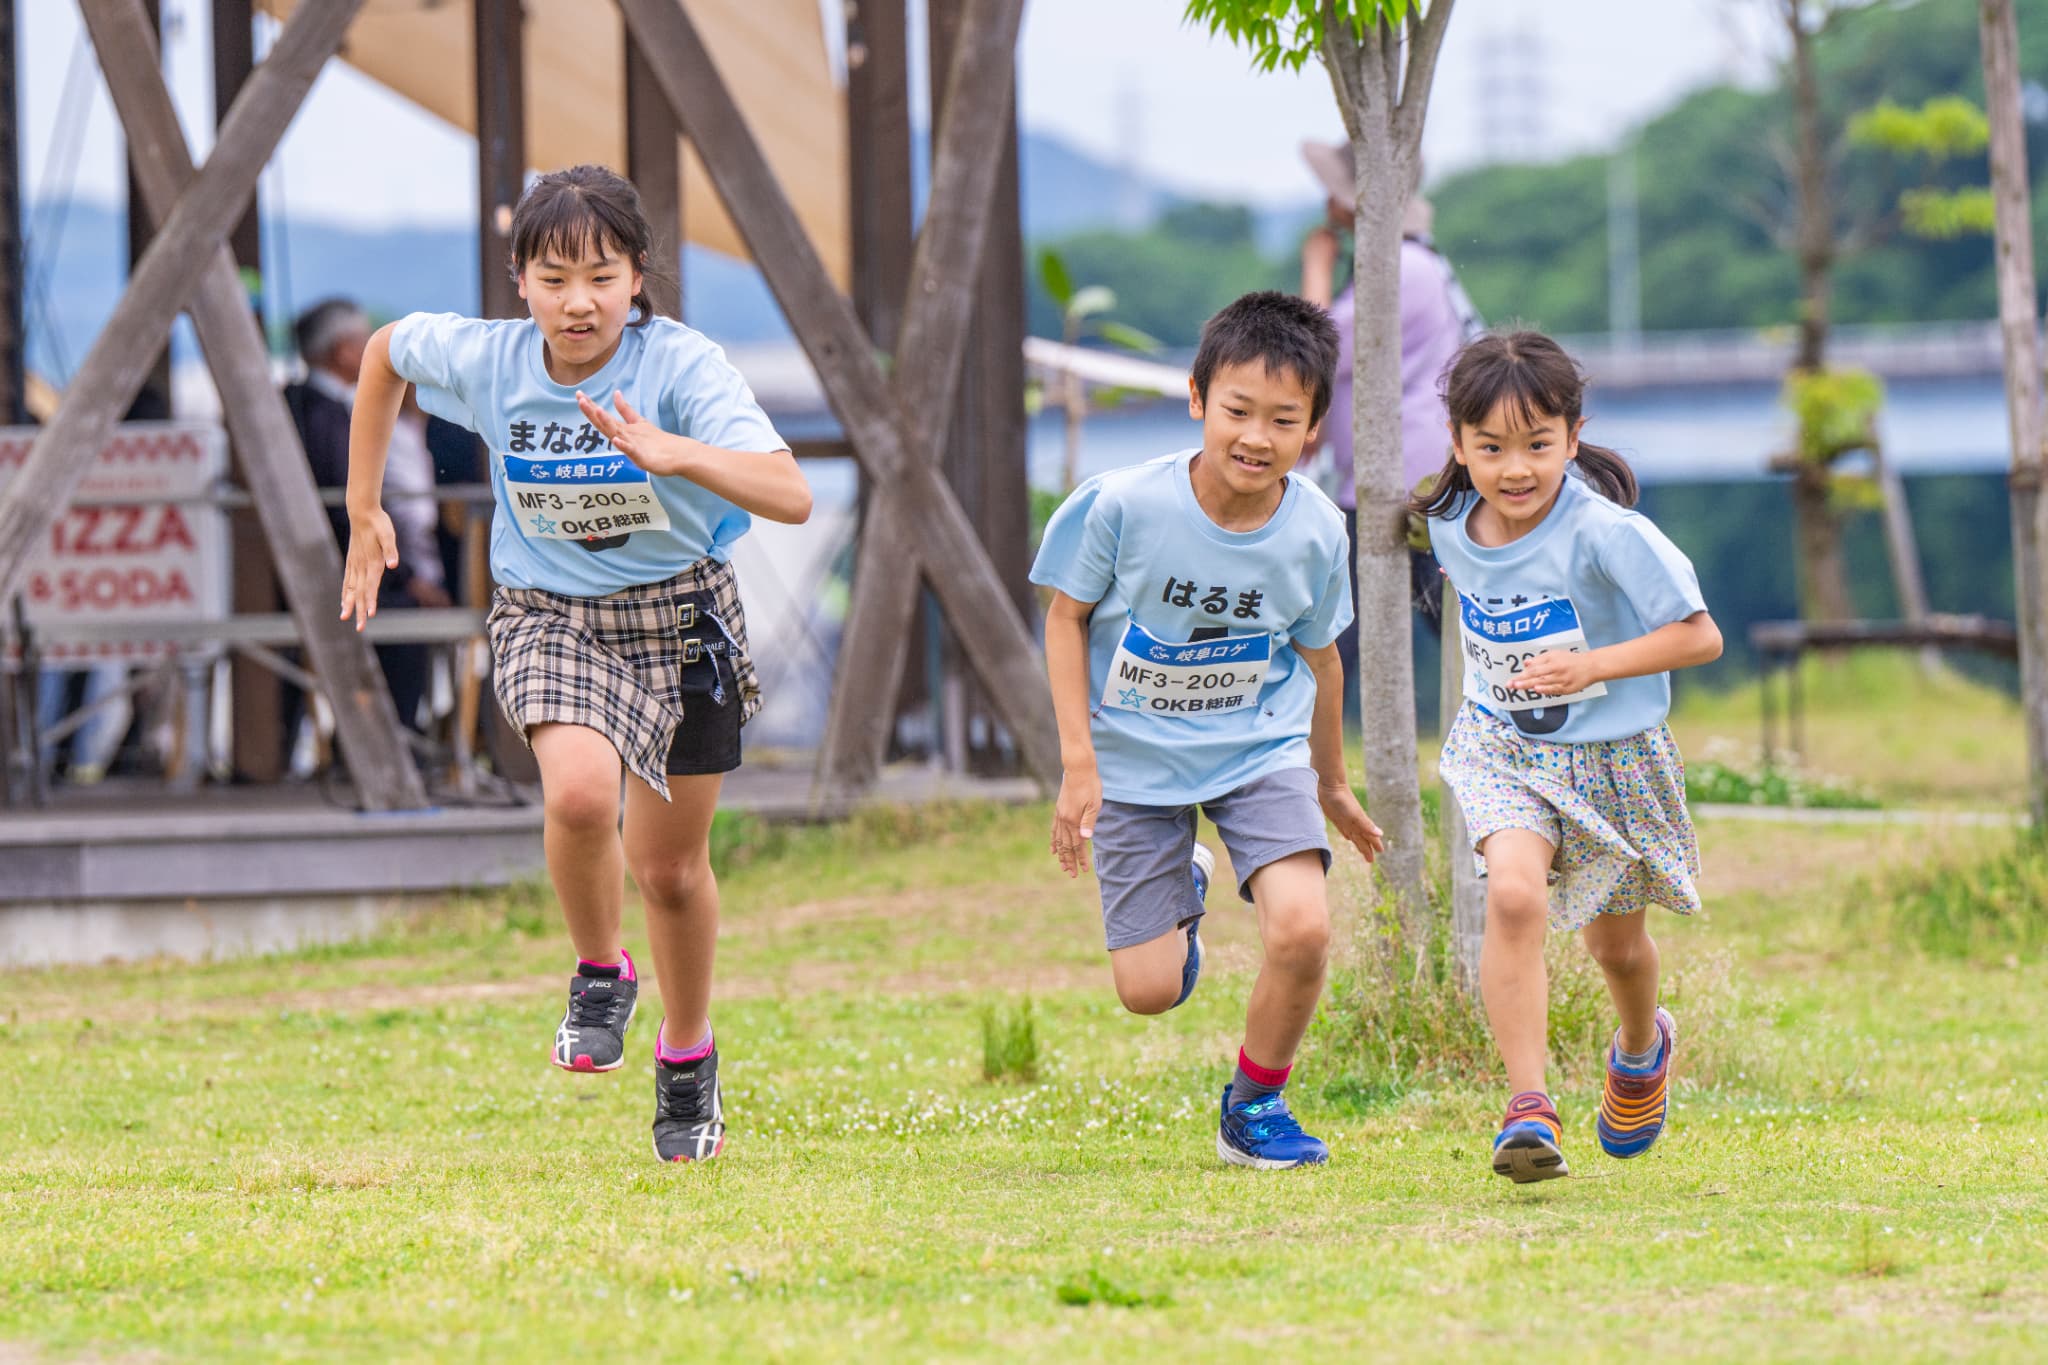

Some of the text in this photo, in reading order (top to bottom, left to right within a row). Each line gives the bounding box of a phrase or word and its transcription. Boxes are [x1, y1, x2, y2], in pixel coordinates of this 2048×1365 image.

[509, 420, 614, 454] まなみ
[555, 461, 624, 478] 岐阜ロゲ
[517, 491, 650, 510] MF3-200-3
[52, 504, 195, 553] IZZA
[561, 512, 651, 534] OKB総研
[1162, 576, 1263, 619] はるま
[1483, 608, 1551, 637] 岐阜ロゲ
[1175, 643, 1250, 662] 岐阜ロゲ
[1119, 660, 1258, 690] MF3-200-4
[1150, 694, 1244, 712] OKB総研
